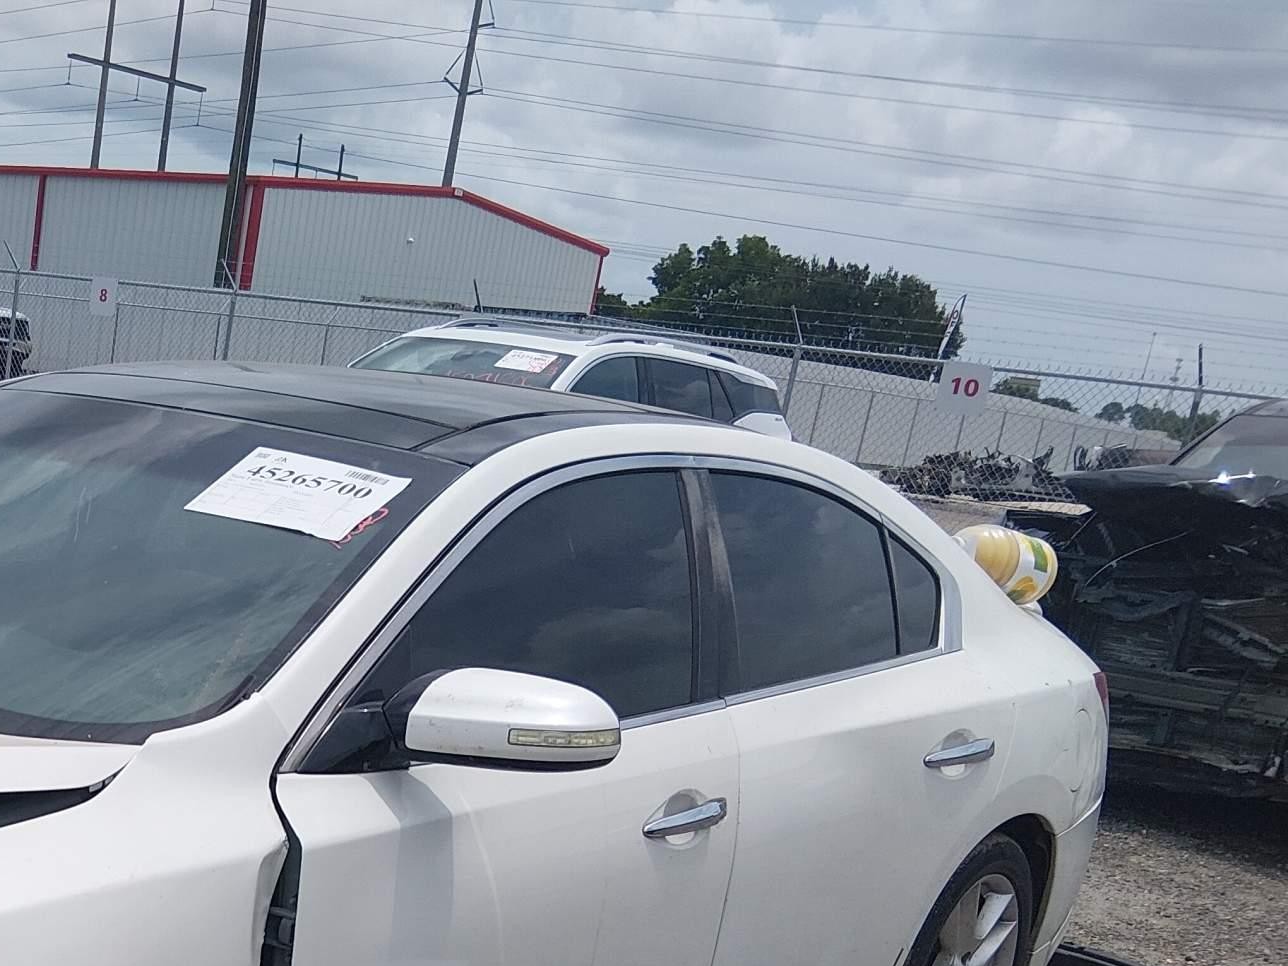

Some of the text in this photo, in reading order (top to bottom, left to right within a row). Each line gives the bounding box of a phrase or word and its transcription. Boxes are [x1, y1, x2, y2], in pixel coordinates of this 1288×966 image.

[99, 288, 108, 302] 8
[951, 377, 979, 397] 10
[246, 465, 373, 499] 45265700
